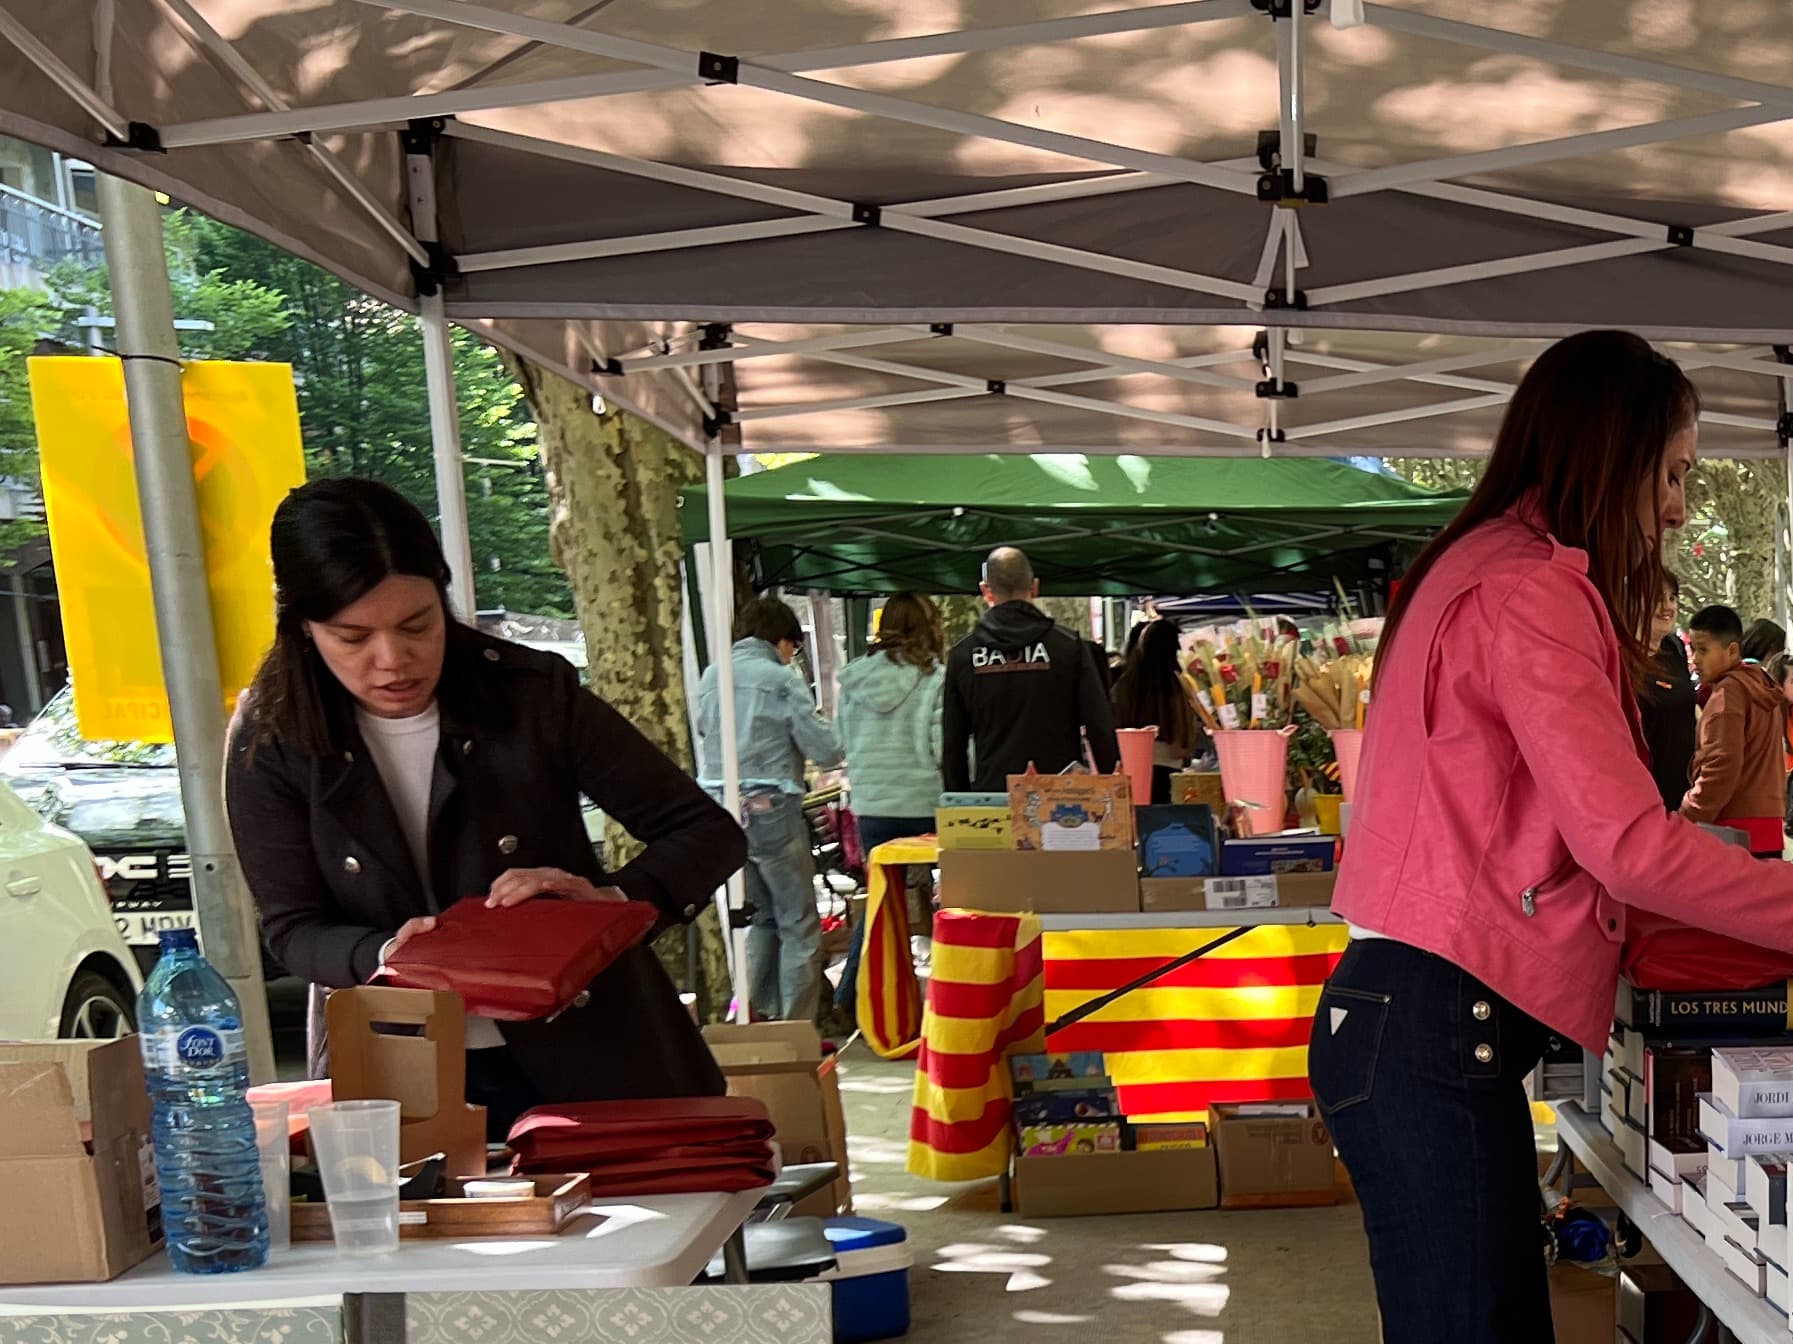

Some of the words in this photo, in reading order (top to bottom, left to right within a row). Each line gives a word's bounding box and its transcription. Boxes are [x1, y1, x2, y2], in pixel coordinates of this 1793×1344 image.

[1671, 1001, 1699, 1015] LOS
[1705, 1001, 1737, 1014] TRES
[1754, 1090, 1789, 1104] JORDI
[1743, 1132, 1781, 1147] JORGE
